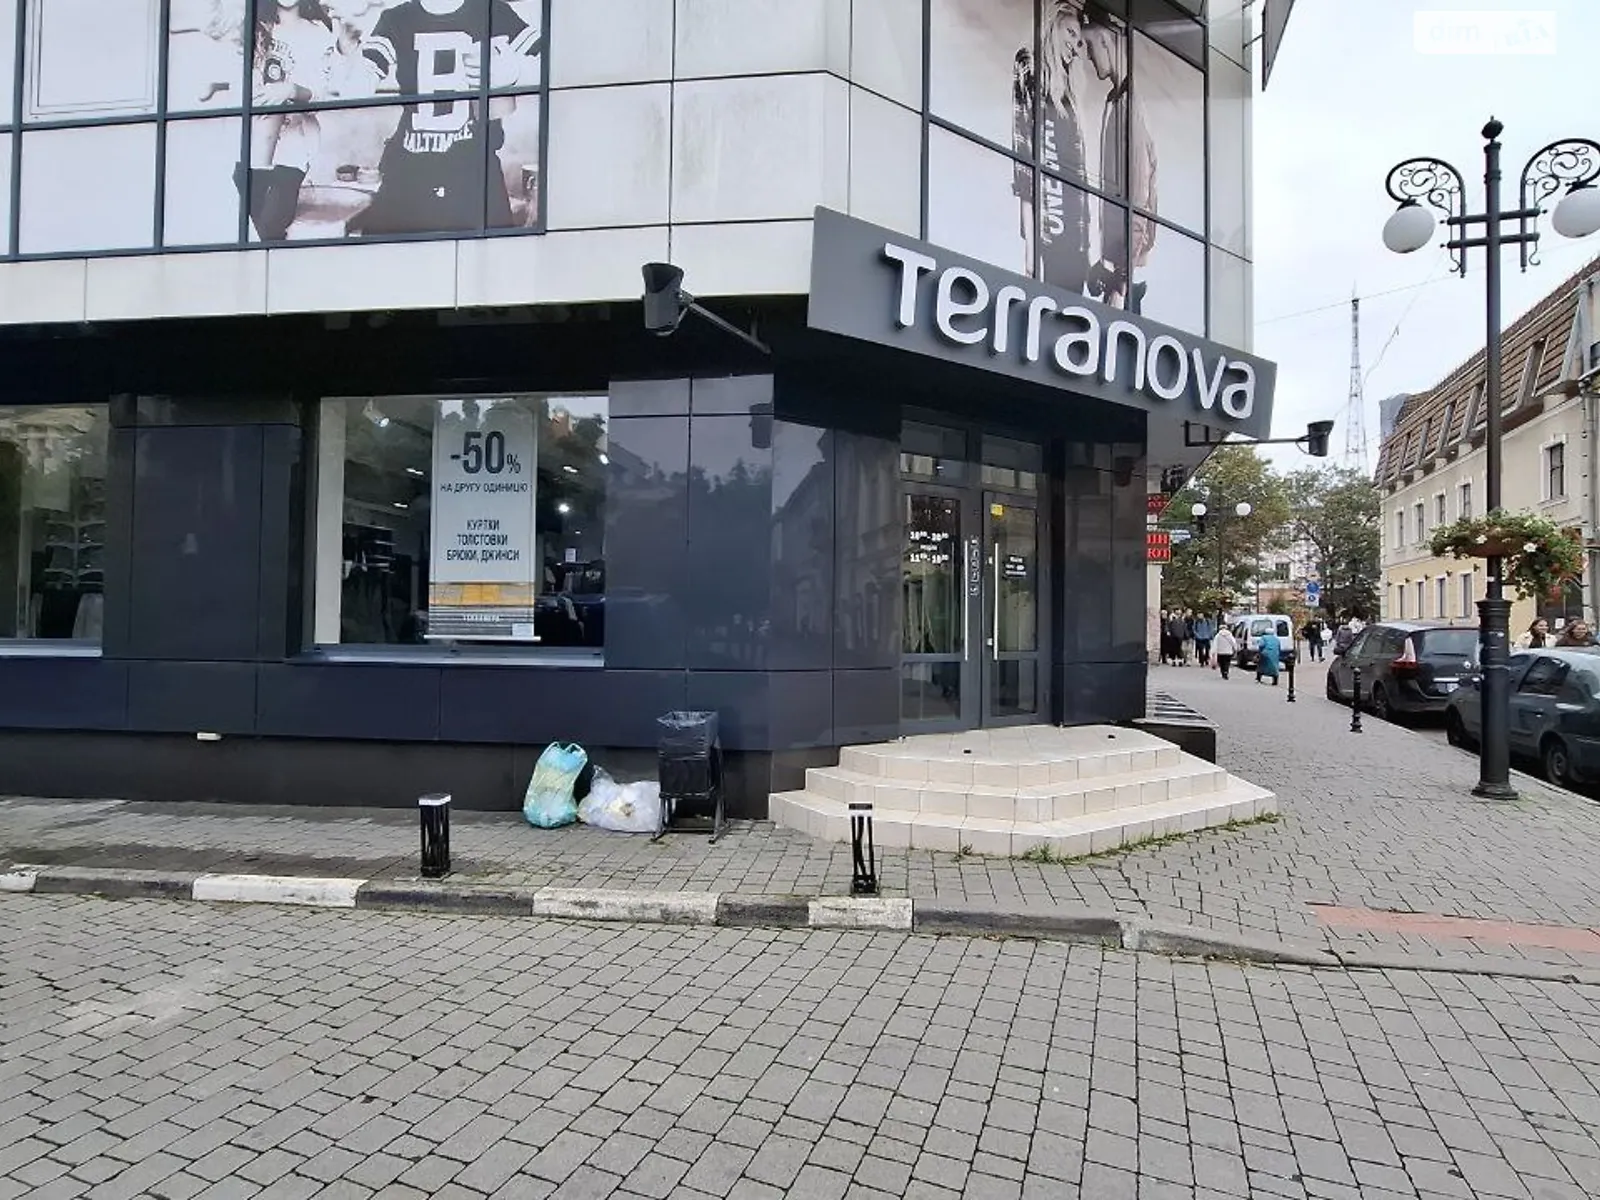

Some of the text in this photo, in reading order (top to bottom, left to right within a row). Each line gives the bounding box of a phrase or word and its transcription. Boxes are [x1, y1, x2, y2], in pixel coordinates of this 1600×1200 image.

[450, 431, 521, 474] -50%
[440, 483, 528, 493] НА ДРУГУ ОДИНИЦЮ
[467, 519, 500, 531] КУРТКИ
[457, 534, 509, 546] ТОЛСТОВКИ
[446, 549, 519, 563] БРЮКИ, ДЖИНСИ
